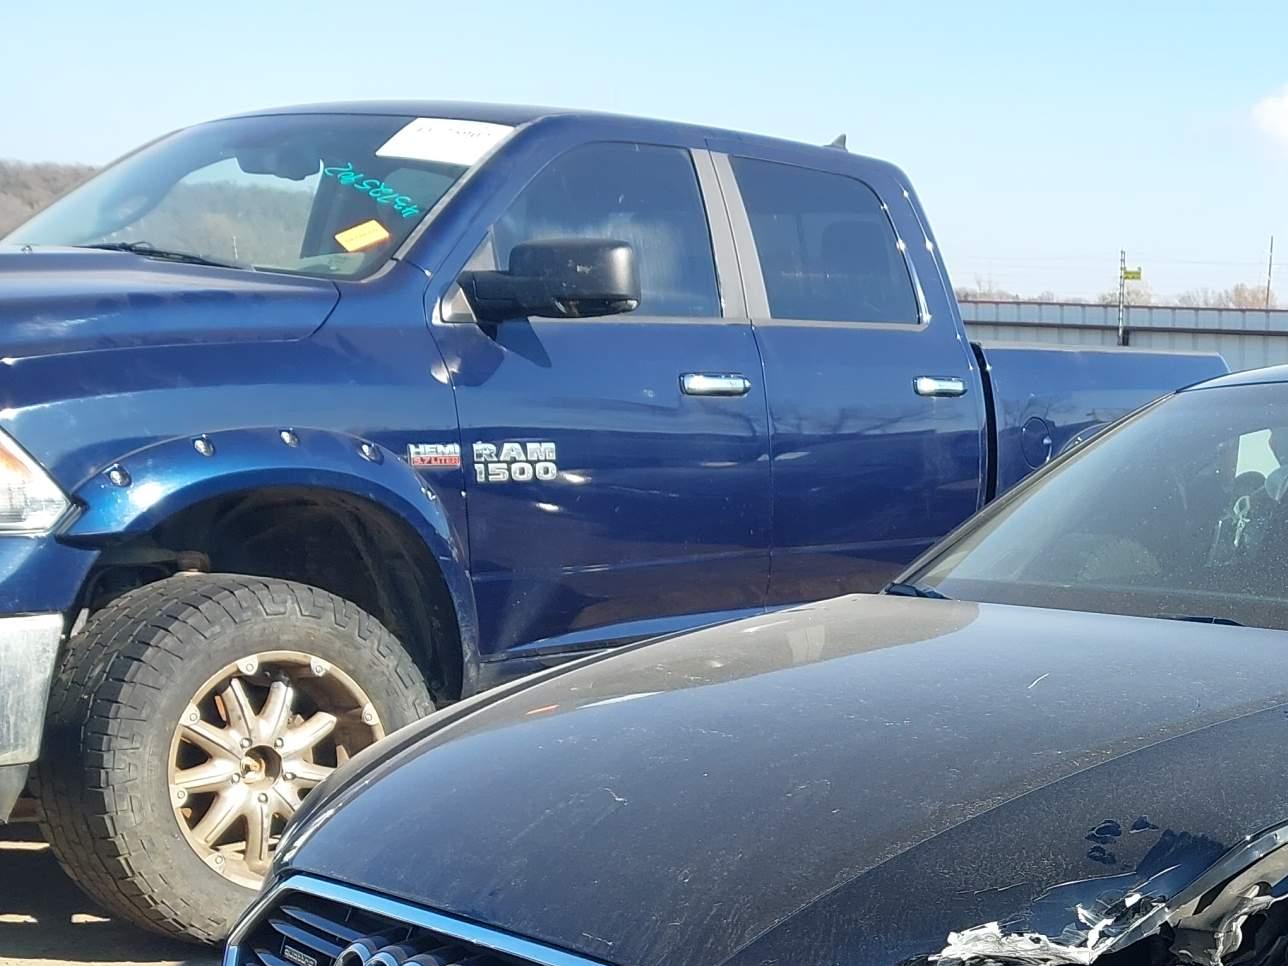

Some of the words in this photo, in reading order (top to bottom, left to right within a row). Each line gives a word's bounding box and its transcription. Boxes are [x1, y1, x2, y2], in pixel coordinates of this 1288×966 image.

[409, 443, 460, 456] HEMI
[473, 442, 556, 461] RAM
[474, 462, 557, 483] 1500
